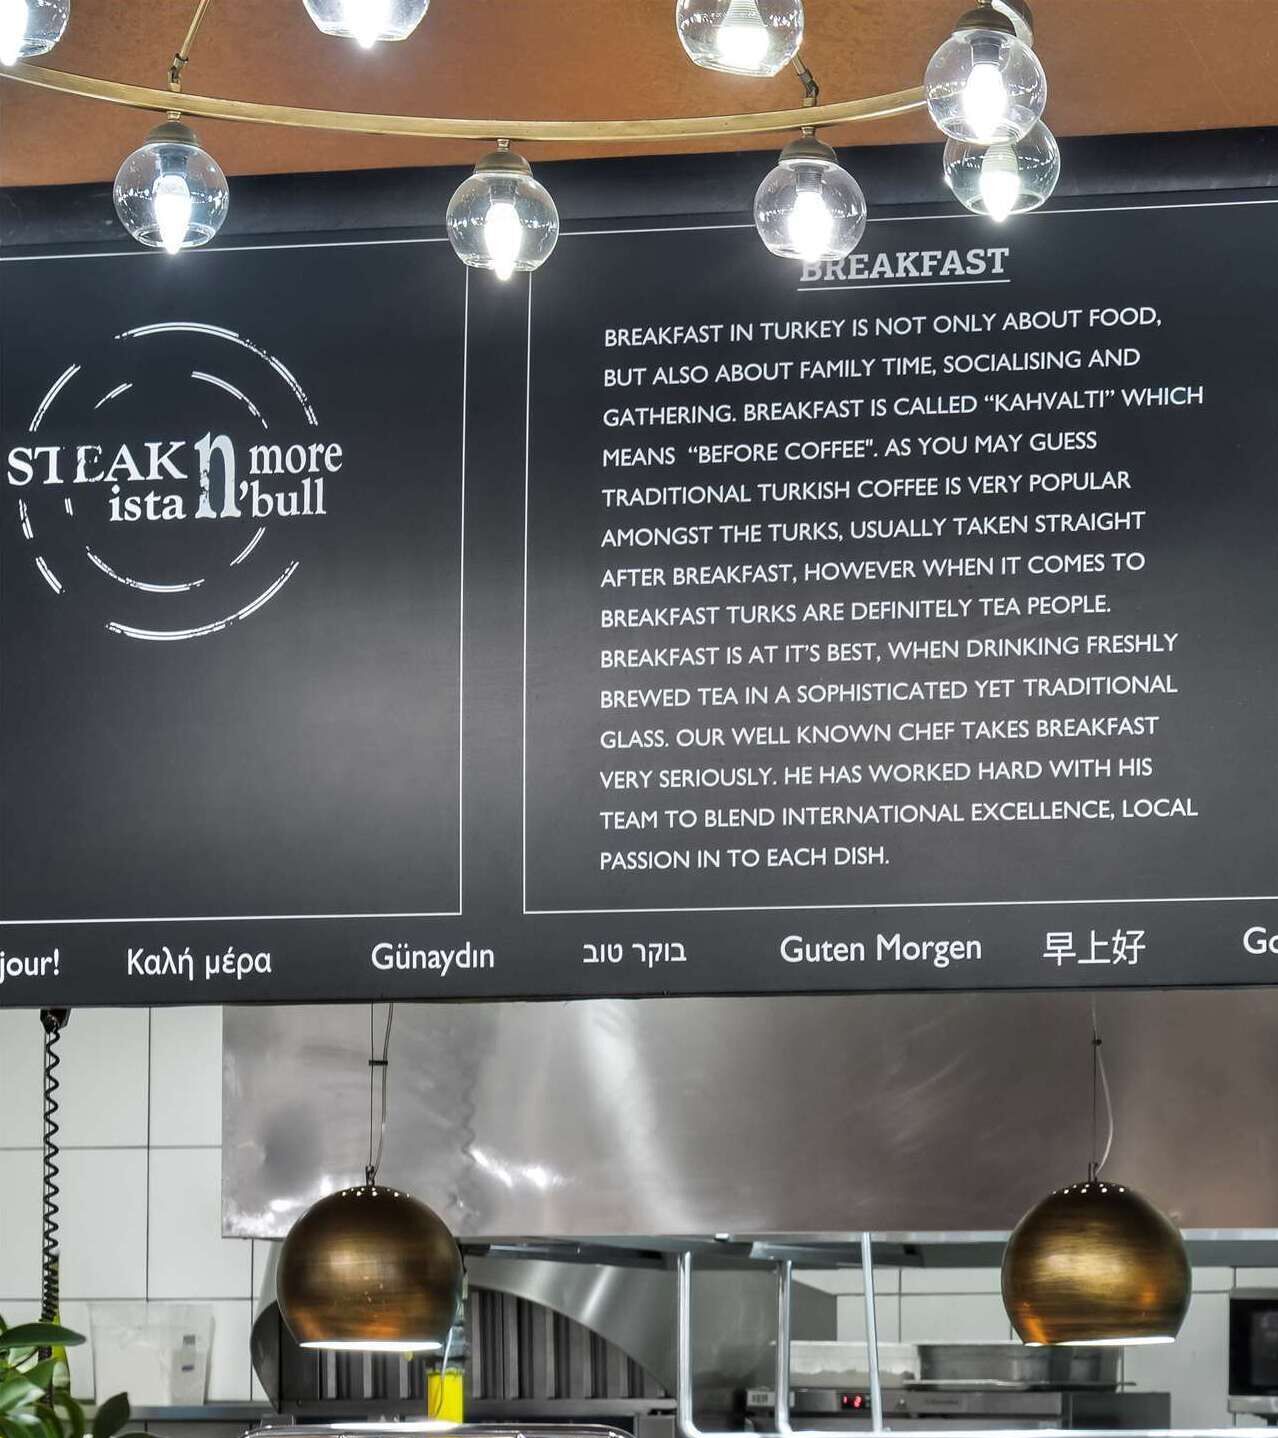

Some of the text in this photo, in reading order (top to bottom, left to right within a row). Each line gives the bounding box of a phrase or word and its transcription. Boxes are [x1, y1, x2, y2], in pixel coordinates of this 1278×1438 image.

[799, 247, 1010, 282] BREAKFAST
[604, 306, 1162, 348] BREAKFAST IN TURKEY IS NOT ONLY ABOUT FOOD,
[603, 347, 1141, 388] BUT ALSO ABOUT FAMILY TIME, SOCIALISING AND
[602, 385, 1204, 428] GATHERING. BREAKFAST IS CALLED “KAHVALTI” WHICH
[7, 440, 188, 486] STEAK
[248, 442, 344, 475] more
[602, 430, 1098, 468] MEANS “BEFORE COFFEE". AS YOU MAY GUESS
[108, 484, 187, 522] ista
[601, 470, 1132, 508] TRADITIONAL TURKISH COFFEE IS VERY POPULAR
[600, 510, 1147, 548] AMONGST THE TURKS, USUALLY TAKEN STRAIGHT
[600, 632, 1179, 669] BREAKFAST IS AT IT’S BEST, WHEN DRINKING FRESHLY
[599, 797, 1199, 830] TEAM TO BLEND INTERNATIONAL EXCELLENCE, LOCAL
[600, 845, 890, 871] PASSION IN TO EACH DISH.
[127, 945, 272, 982] Καλή μέρα
[371, 940, 495, 977] Günaydın
[582, 942, 688, 969] בוקר טוב
[780, 932, 982, 969] Guten Morgen
[1042, 928, 1147, 967] 早上好
